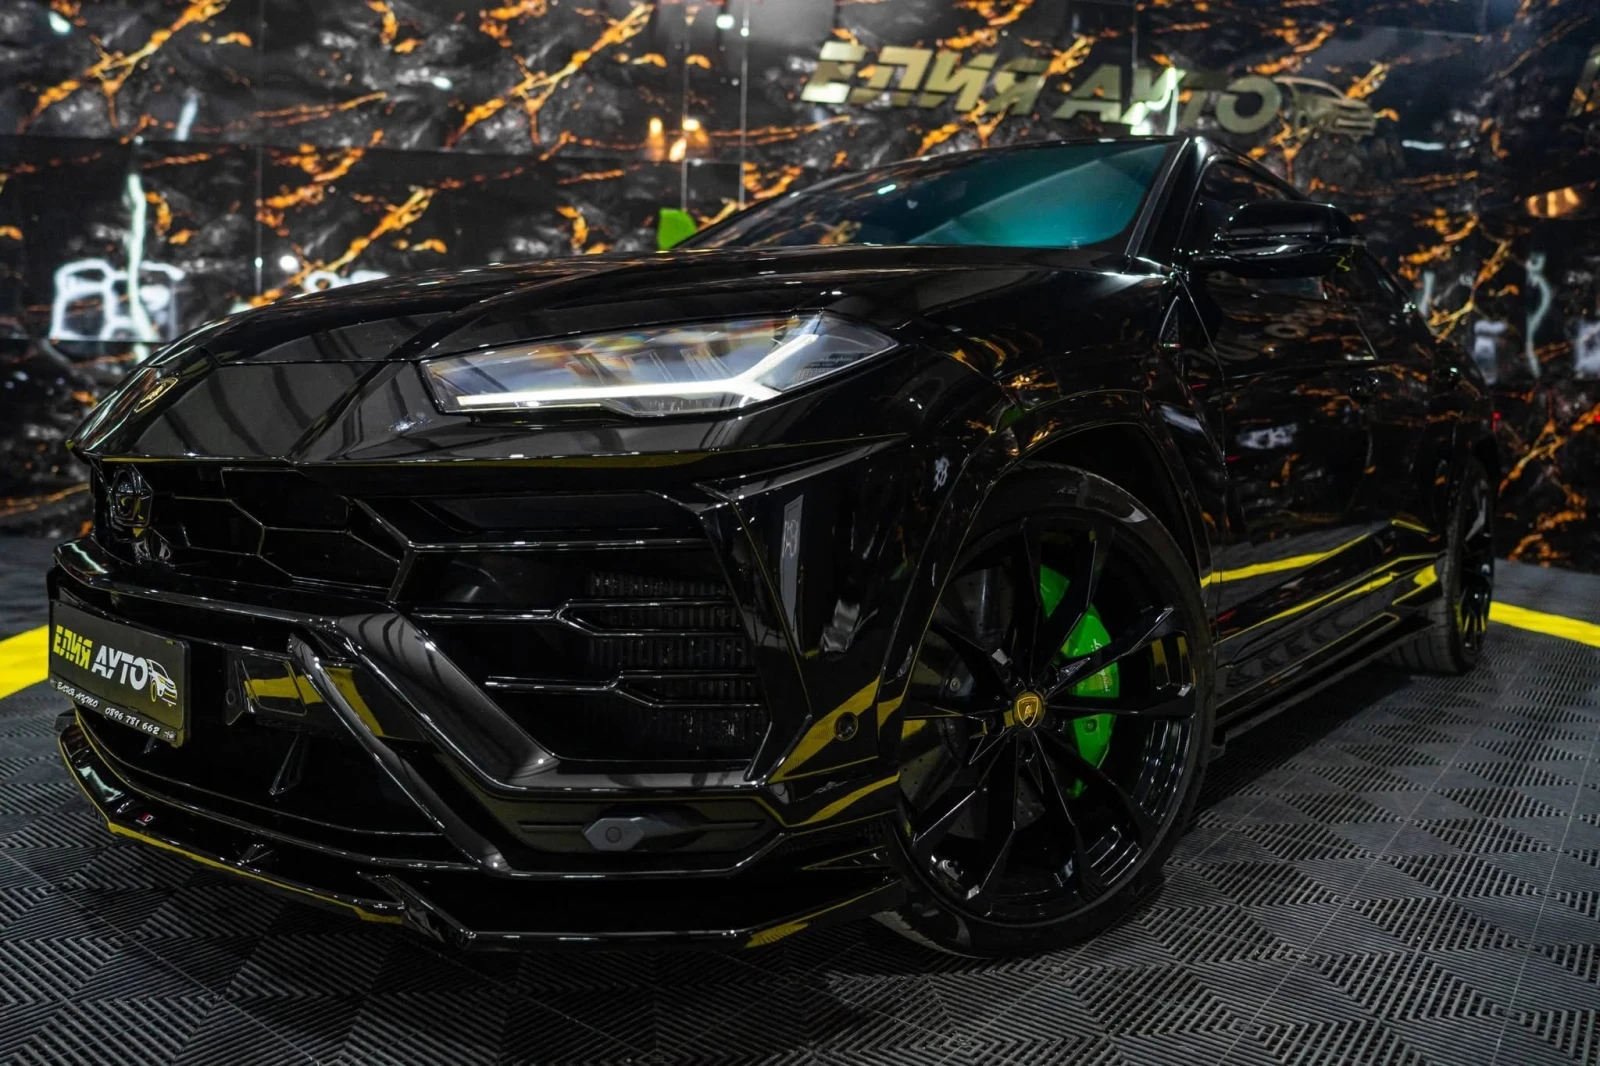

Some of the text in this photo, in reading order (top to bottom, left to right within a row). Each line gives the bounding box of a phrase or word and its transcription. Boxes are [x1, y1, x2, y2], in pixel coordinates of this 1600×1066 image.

[105, 707, 123, 720] 0896
[125, 715, 141, 727] 781
[141, 722, 160, 735] 662
